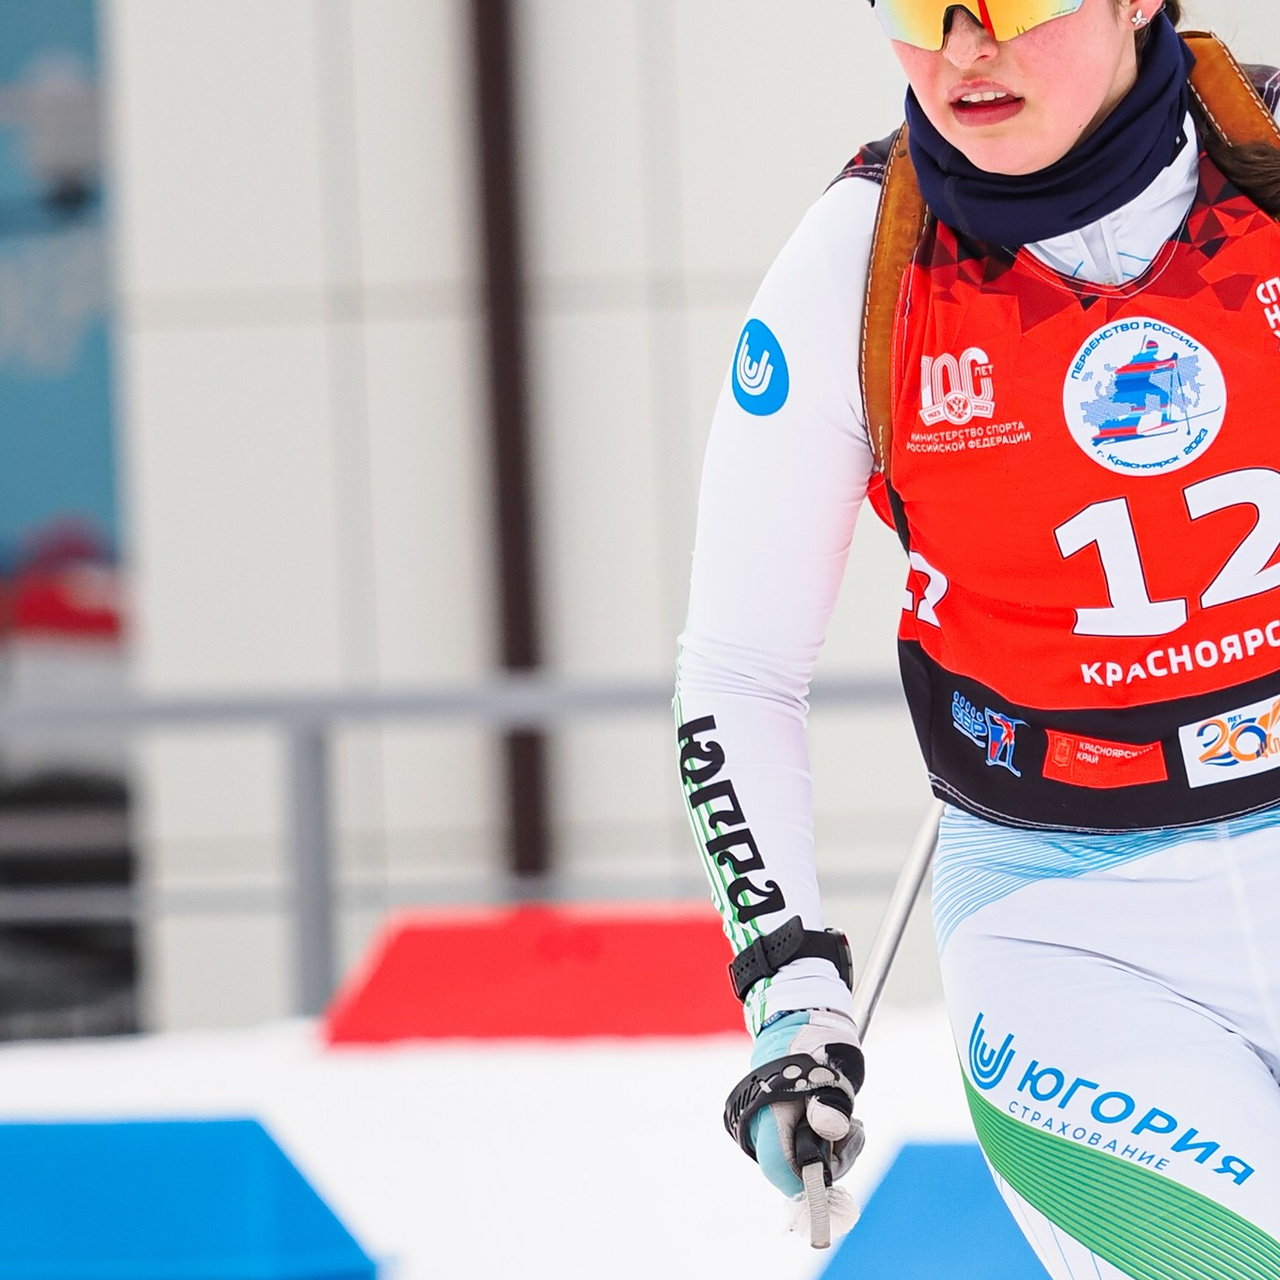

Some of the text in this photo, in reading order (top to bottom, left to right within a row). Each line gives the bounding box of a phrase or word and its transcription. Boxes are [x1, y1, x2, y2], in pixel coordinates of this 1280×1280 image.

[974, 365, 994, 376] ЛЕТ
[1071, 321, 1200, 380] ПЕРВЕНСТВО РОССИИ
[921, 347, 994, 409] 100
[906, 432, 1031, 453] РОССИЙСКОЙ ФЕДЕРАЦИИ
[911, 421, 1025, 442] МИНИСТЕРСТВО СПОРТА
[1107, 454, 1180, 469] Красноярск
[1183, 428, 1209, 455] 2023
[1227, 714, 1242, 723] ЛЕТ
[1076, 751, 1099, 765] КРАЙ
[1197, 718, 1268, 763] 20
[1008, 1101, 1171, 1171] СТРАХОВАНИЕ
[1017, 1060, 1255, 1186] ЮГОРИЯ
